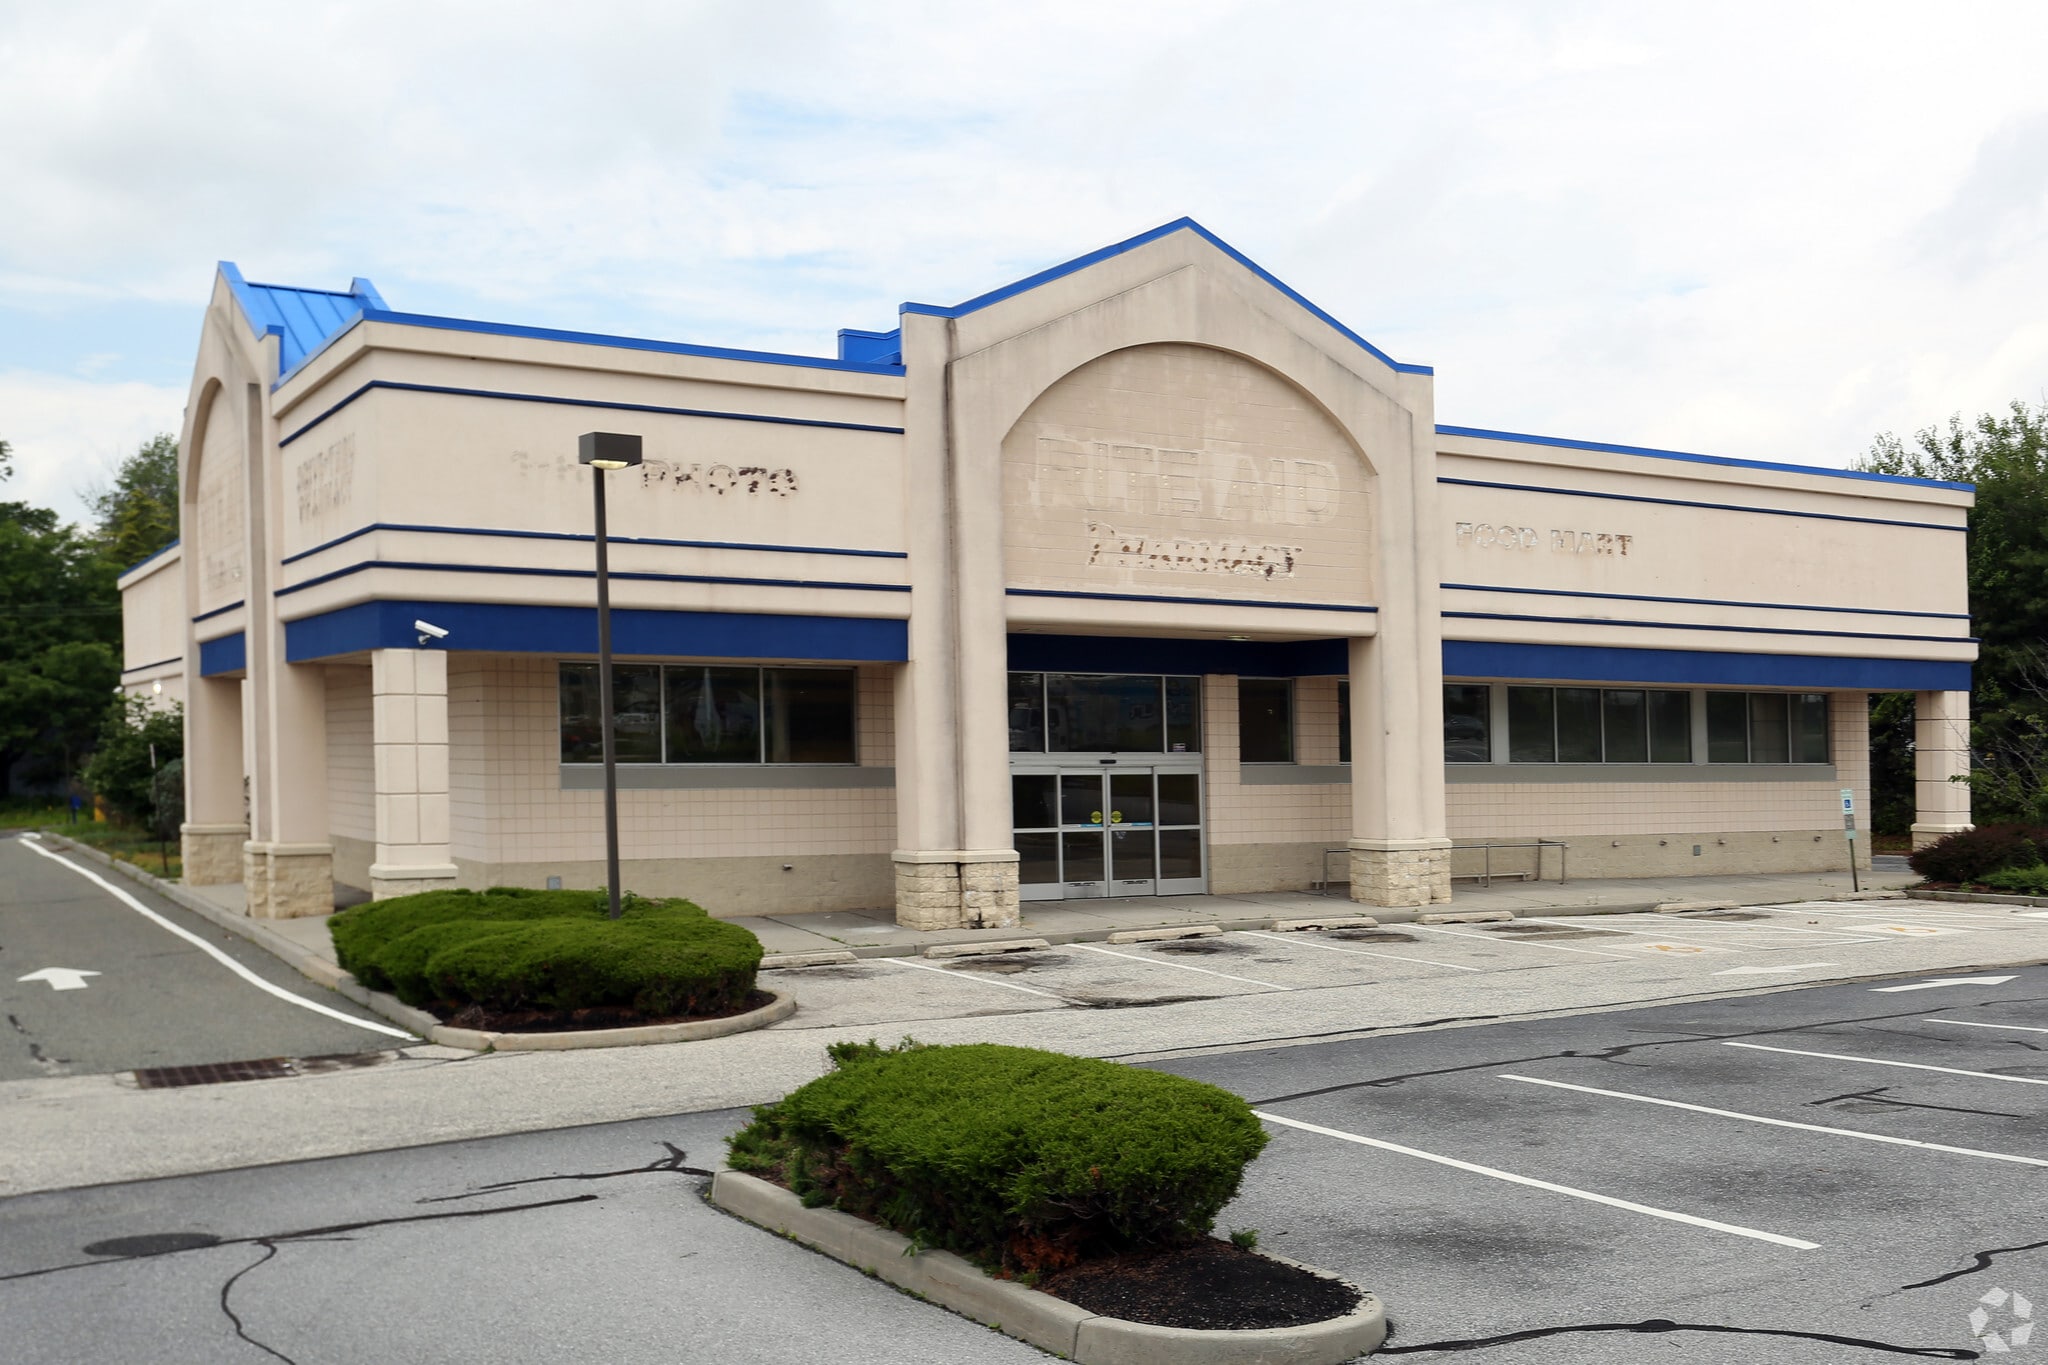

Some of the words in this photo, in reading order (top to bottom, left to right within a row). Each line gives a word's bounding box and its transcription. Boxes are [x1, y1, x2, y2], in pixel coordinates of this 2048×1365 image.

[641, 458, 799, 498] PHOTO
[1036, 437, 1201, 514] RITE
[1208, 453, 1339, 525] AID
[1456, 522, 1538, 550] FOOD
[1551, 530, 1633, 557] MART
